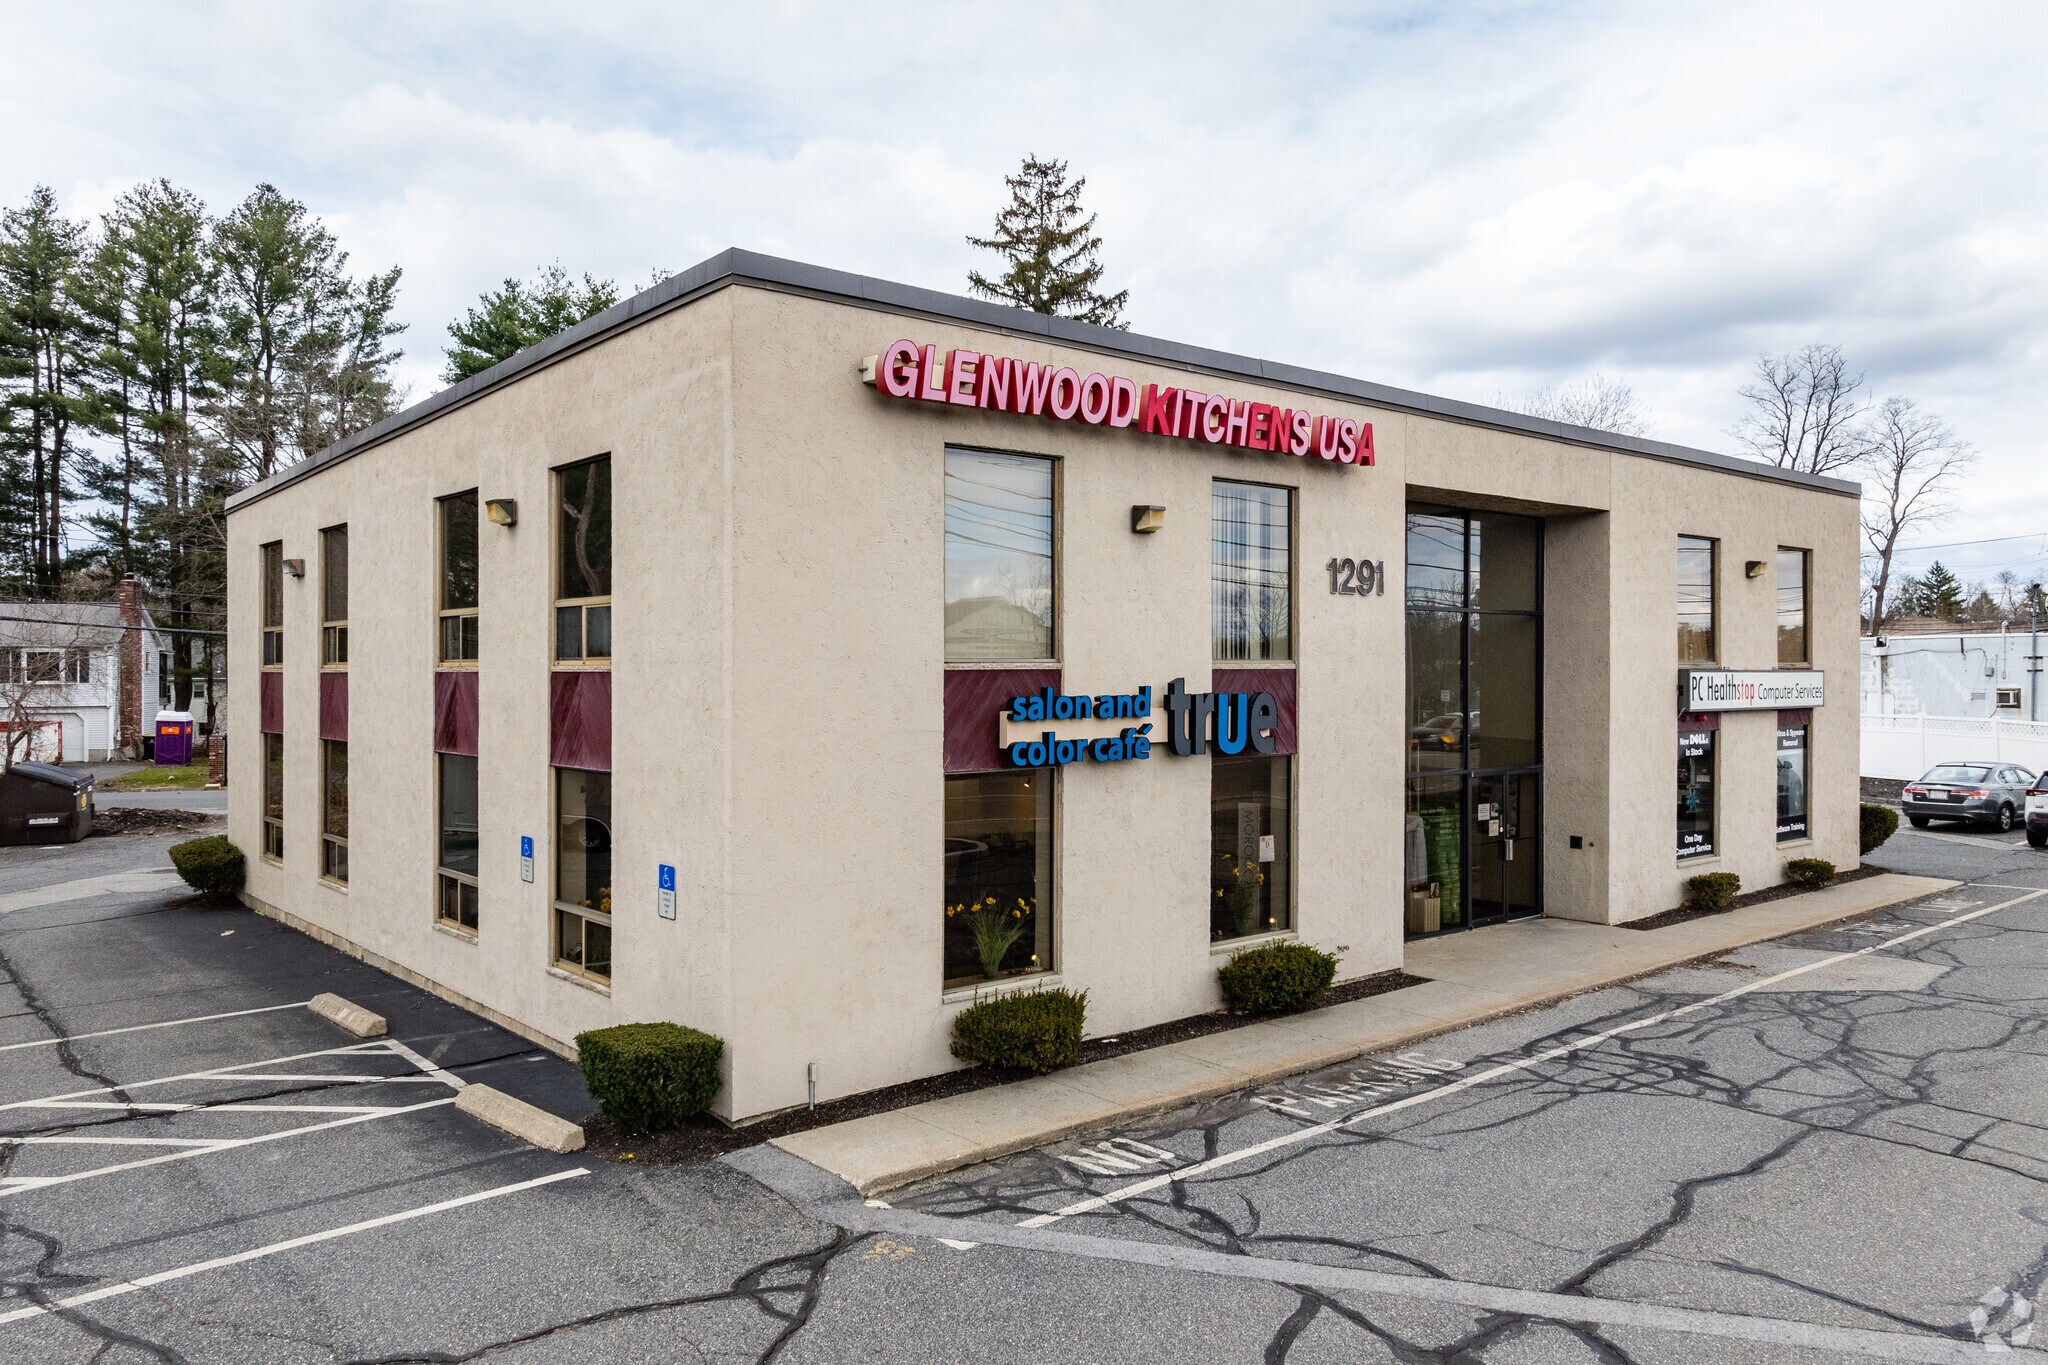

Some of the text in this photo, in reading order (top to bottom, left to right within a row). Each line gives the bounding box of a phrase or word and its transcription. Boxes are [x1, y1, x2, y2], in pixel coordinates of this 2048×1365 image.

[878, 338, 1376, 467] GLENWOOD KITCHENS USA
[1326, 557, 1385, 597] 1291
[1009, 685, 1152, 722] salon and
[1692, 674, 1823, 706] PC Healthstop Computer Services
[1166, 678, 1279, 756] true
[1009, 723, 1154, 766] color café
[1680, 737, 1689, 746] New
[1685, 747, 1703, 756] In Stock
[1684, 833, 1703, 843] One Day
[1695, 843, 1712, 852] Service
[1057, 1136, 1176, 1176] NO
